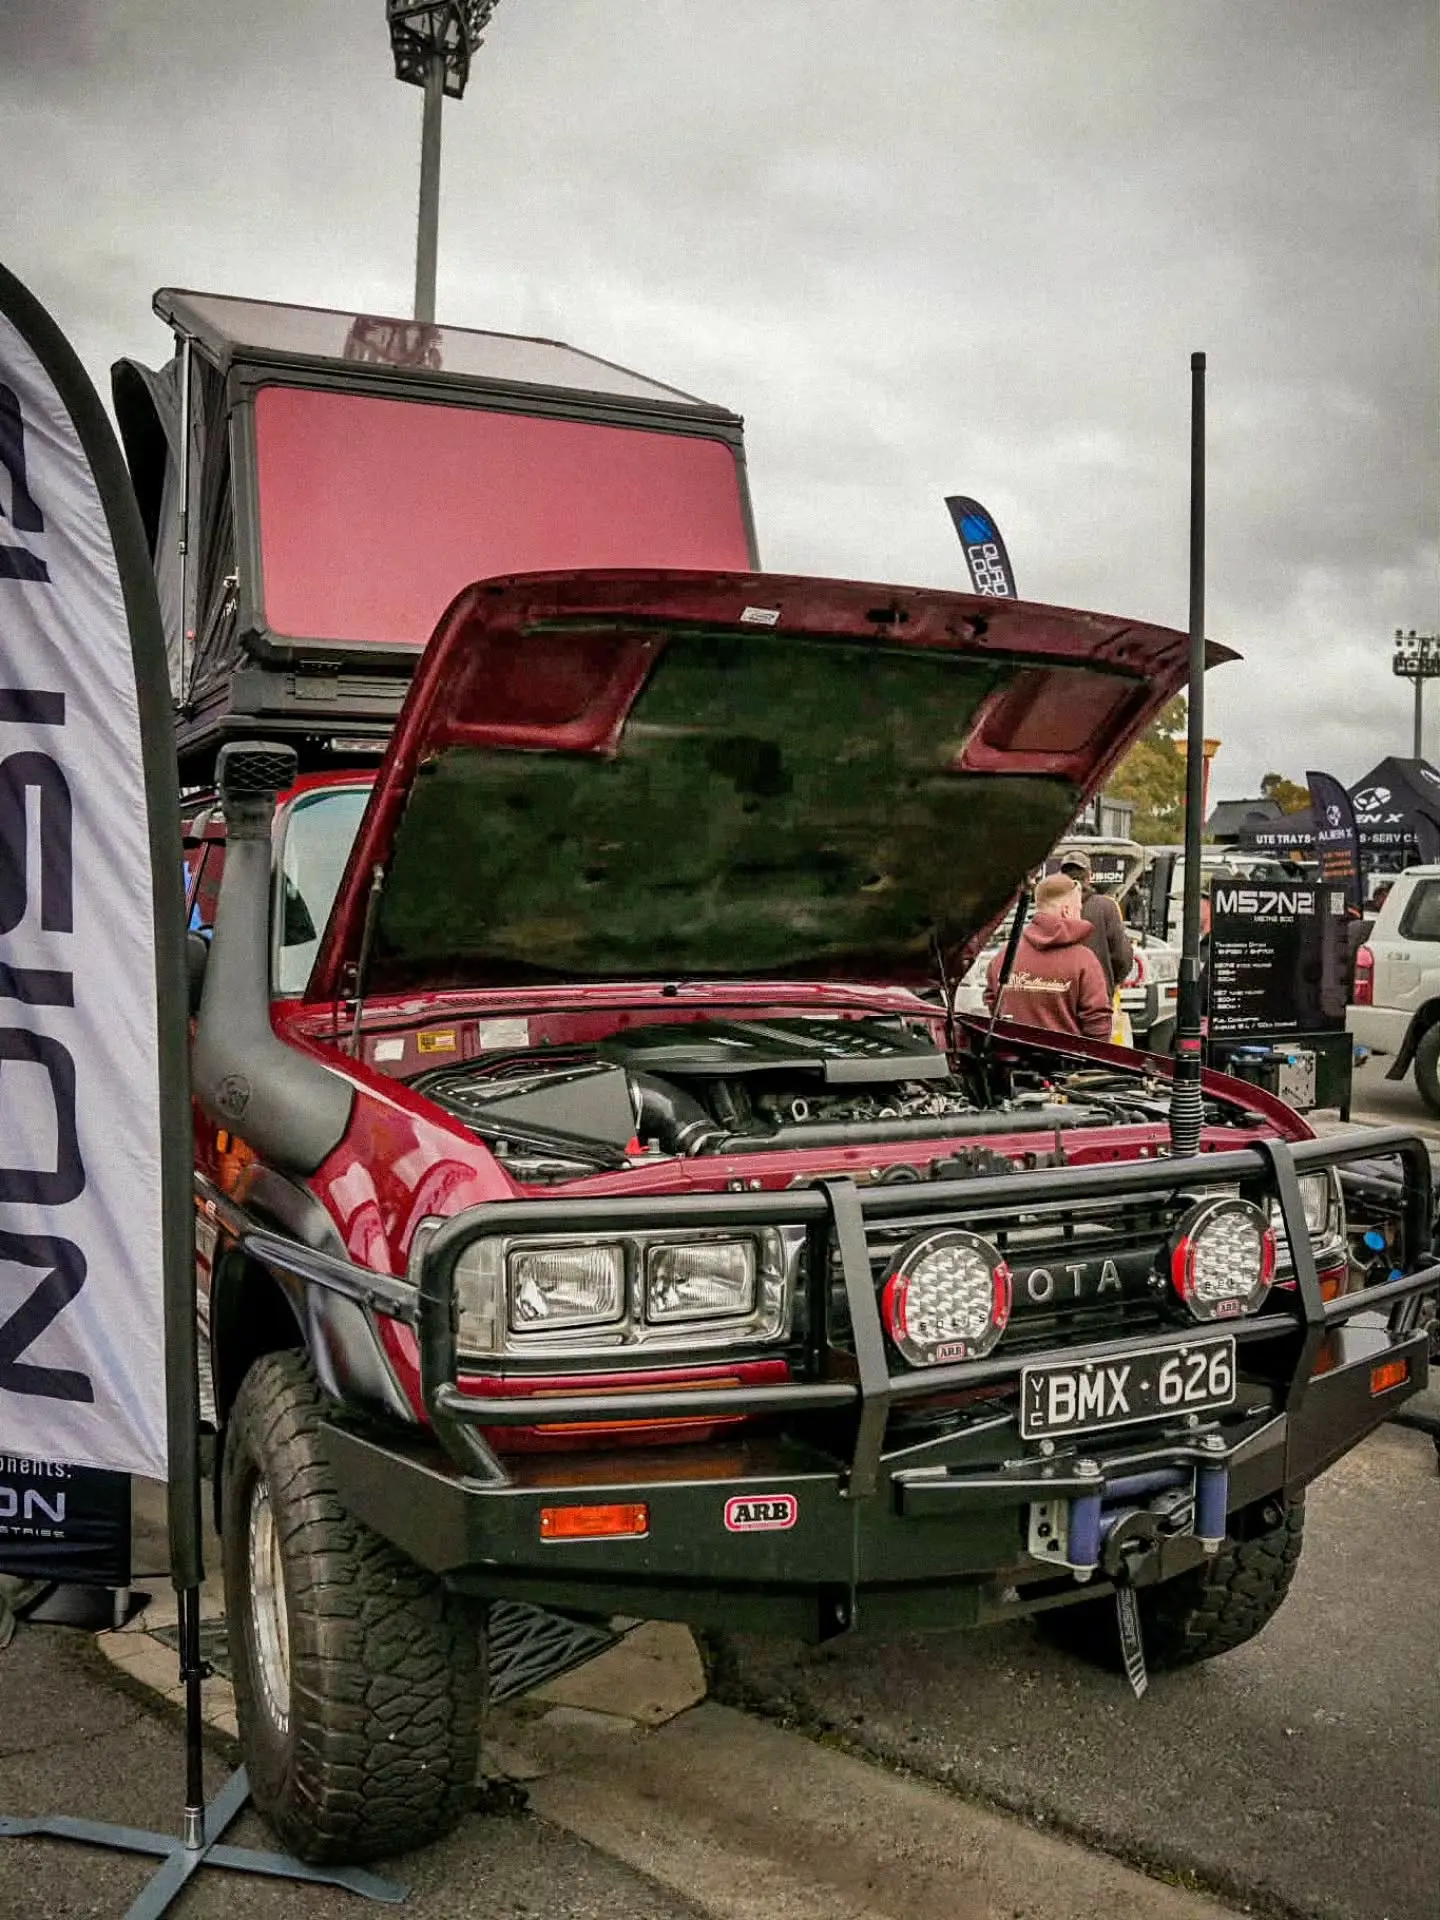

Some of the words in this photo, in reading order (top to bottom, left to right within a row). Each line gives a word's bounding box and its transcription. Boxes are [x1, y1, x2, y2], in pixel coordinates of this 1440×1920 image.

[1256, 834, 1275, 844] UTE
[1048, 1366, 1131, 1424] BMX
[1159, 1349, 1231, 1405] 626
[734, 1503, 789, 1523] ARB
